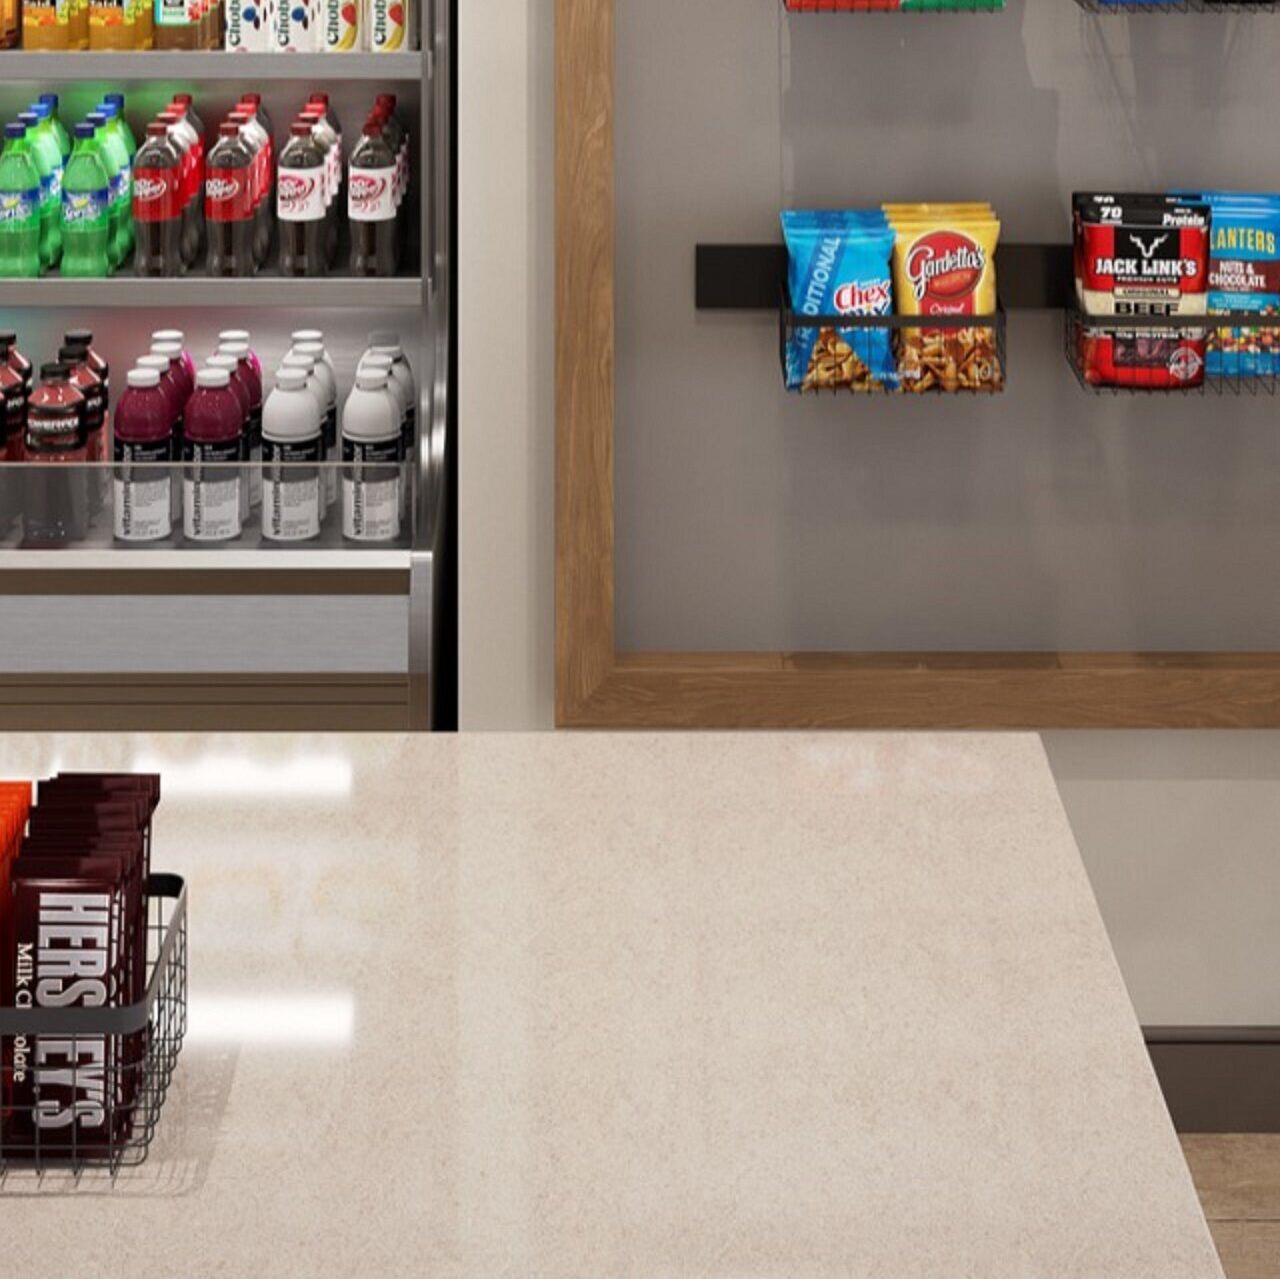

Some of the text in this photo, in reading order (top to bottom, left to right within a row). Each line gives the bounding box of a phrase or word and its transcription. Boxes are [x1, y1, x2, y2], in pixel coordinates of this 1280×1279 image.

[1100, 206, 1123, 220] 70
[1163, 214, 1206, 227] Protein
[1210, 228, 1276, 254] LANTERS
[907, 245, 985, 301] Gardetto's
[1096, 259, 1197, 276] JACK LINK'S
[798, 236, 842, 350] TRDITIONAL
[1208, 273, 1266, 289] CHOCOLATE
[835, 281, 890, 311] Chex
[1114, 303, 1180, 316] BEEF
[13, 942, 33, 1083] Milk Colate
[33, 892, 111, 1129] HERSEY'S
